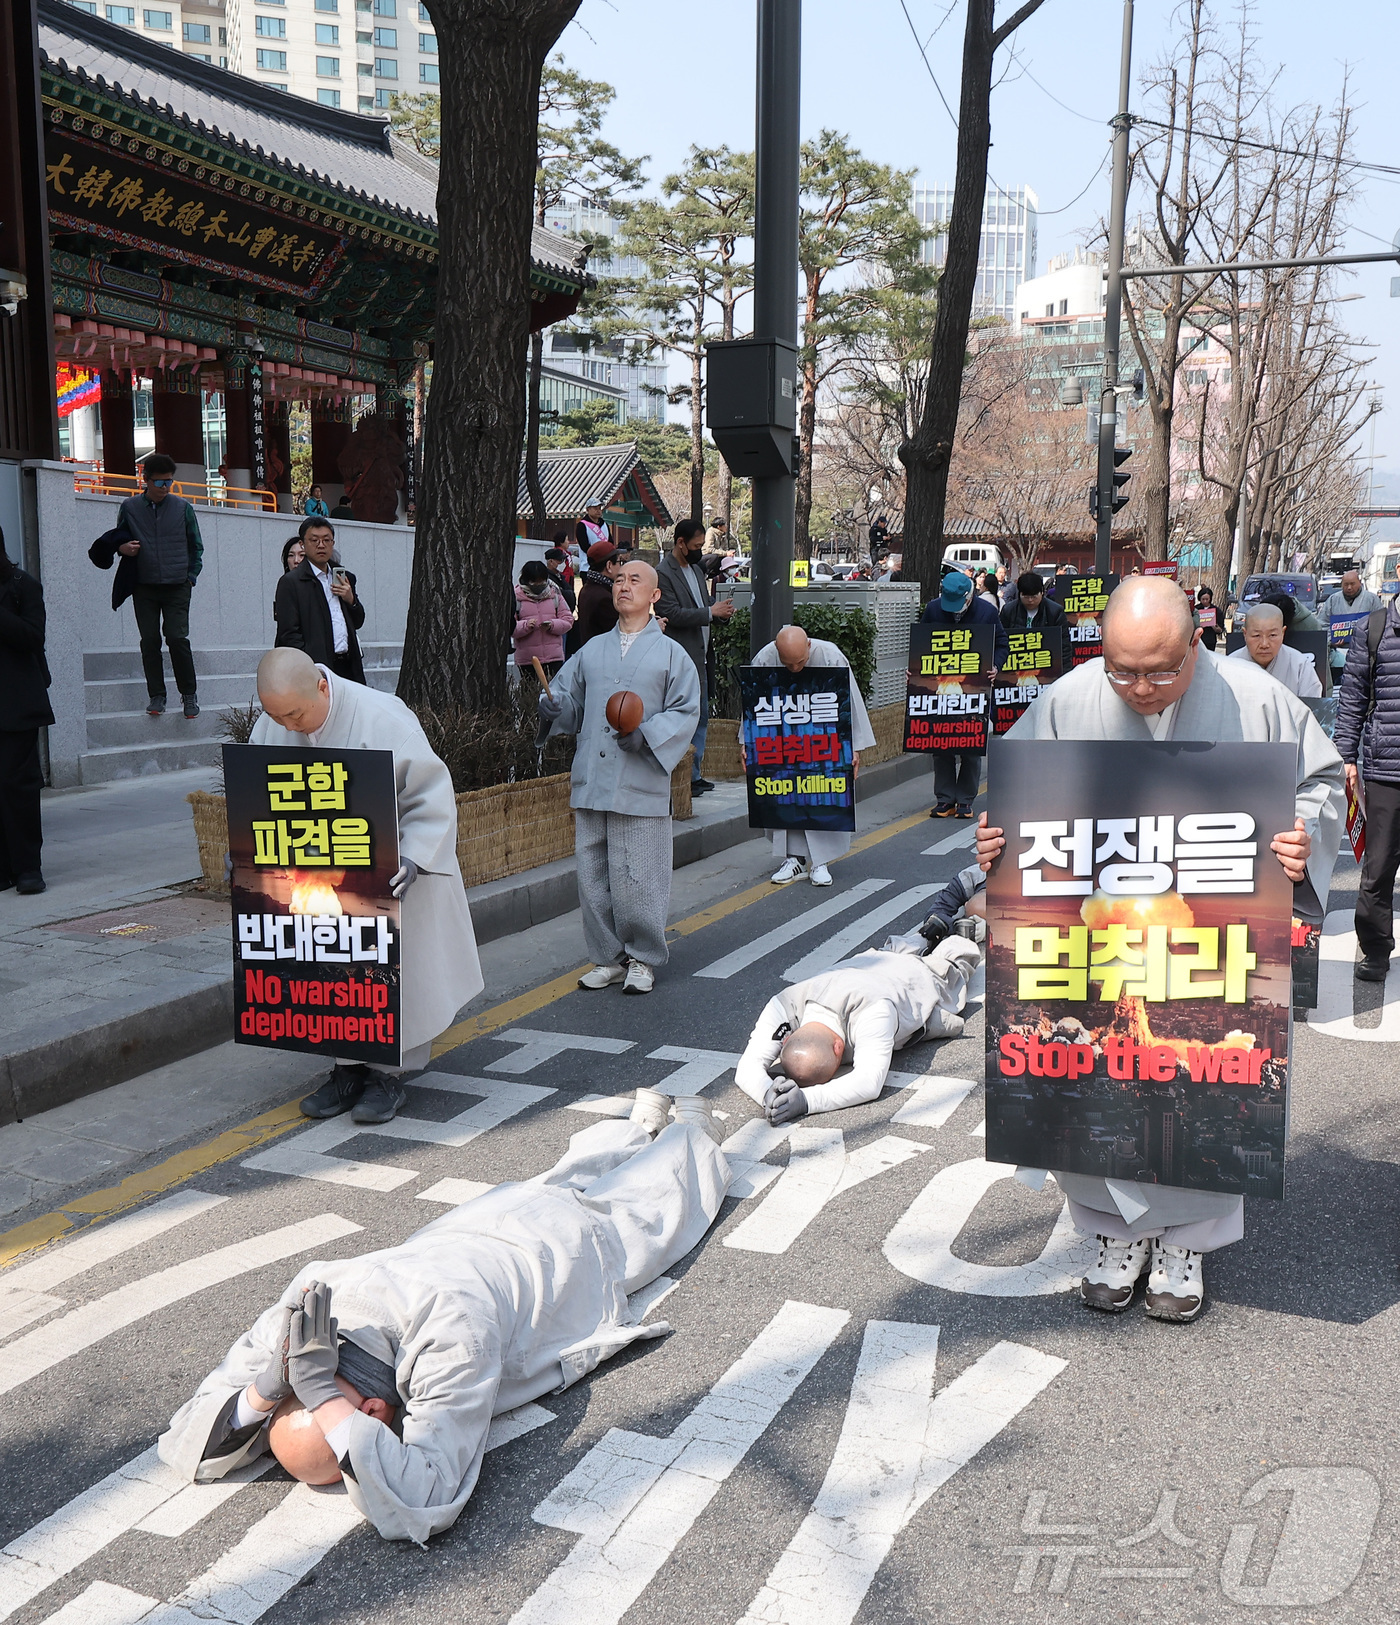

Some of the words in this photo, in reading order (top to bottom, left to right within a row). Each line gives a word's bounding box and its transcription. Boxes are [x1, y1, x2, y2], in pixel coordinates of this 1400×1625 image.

[1071, 577, 1104, 595] 군함
[1064, 594, 1110, 613] 파견을
[931, 629, 973, 652] 군함
[1008, 631, 1043, 652] 군함
[1068, 624, 1103, 642] 대한
[920, 652, 981, 675] 파견을
[908, 693, 988, 716] 반대한다
[994, 684, 1049, 706] 반대한
[753, 692, 840, 726] 살생을
[997, 707, 1014, 720] No
[910, 719, 930, 735] No
[933, 720, 983, 735] warship
[755, 732, 842, 765] 멈춰라
[906, 734, 985, 750] deployment!
[267, 762, 348, 811] 군함
[754, 777, 793, 796] Stop
[796, 775, 847, 794] killing
[252, 817, 371, 867] 파견을
[1018, 812, 1258, 897] 전쟁을
[238, 913, 394, 965] 반대한다
[1291, 925, 1312, 947] ar
[1014, 923, 1258, 1003] 멈춰라
[245, 969, 282, 1005] No
[289, 976, 388, 1013] warship
[240, 1007, 394, 1044] deployment!
[999, 1033, 1095, 1080] Stop
[1103, 1036, 1177, 1082] the
[1186, 1046, 1273, 1085] war
